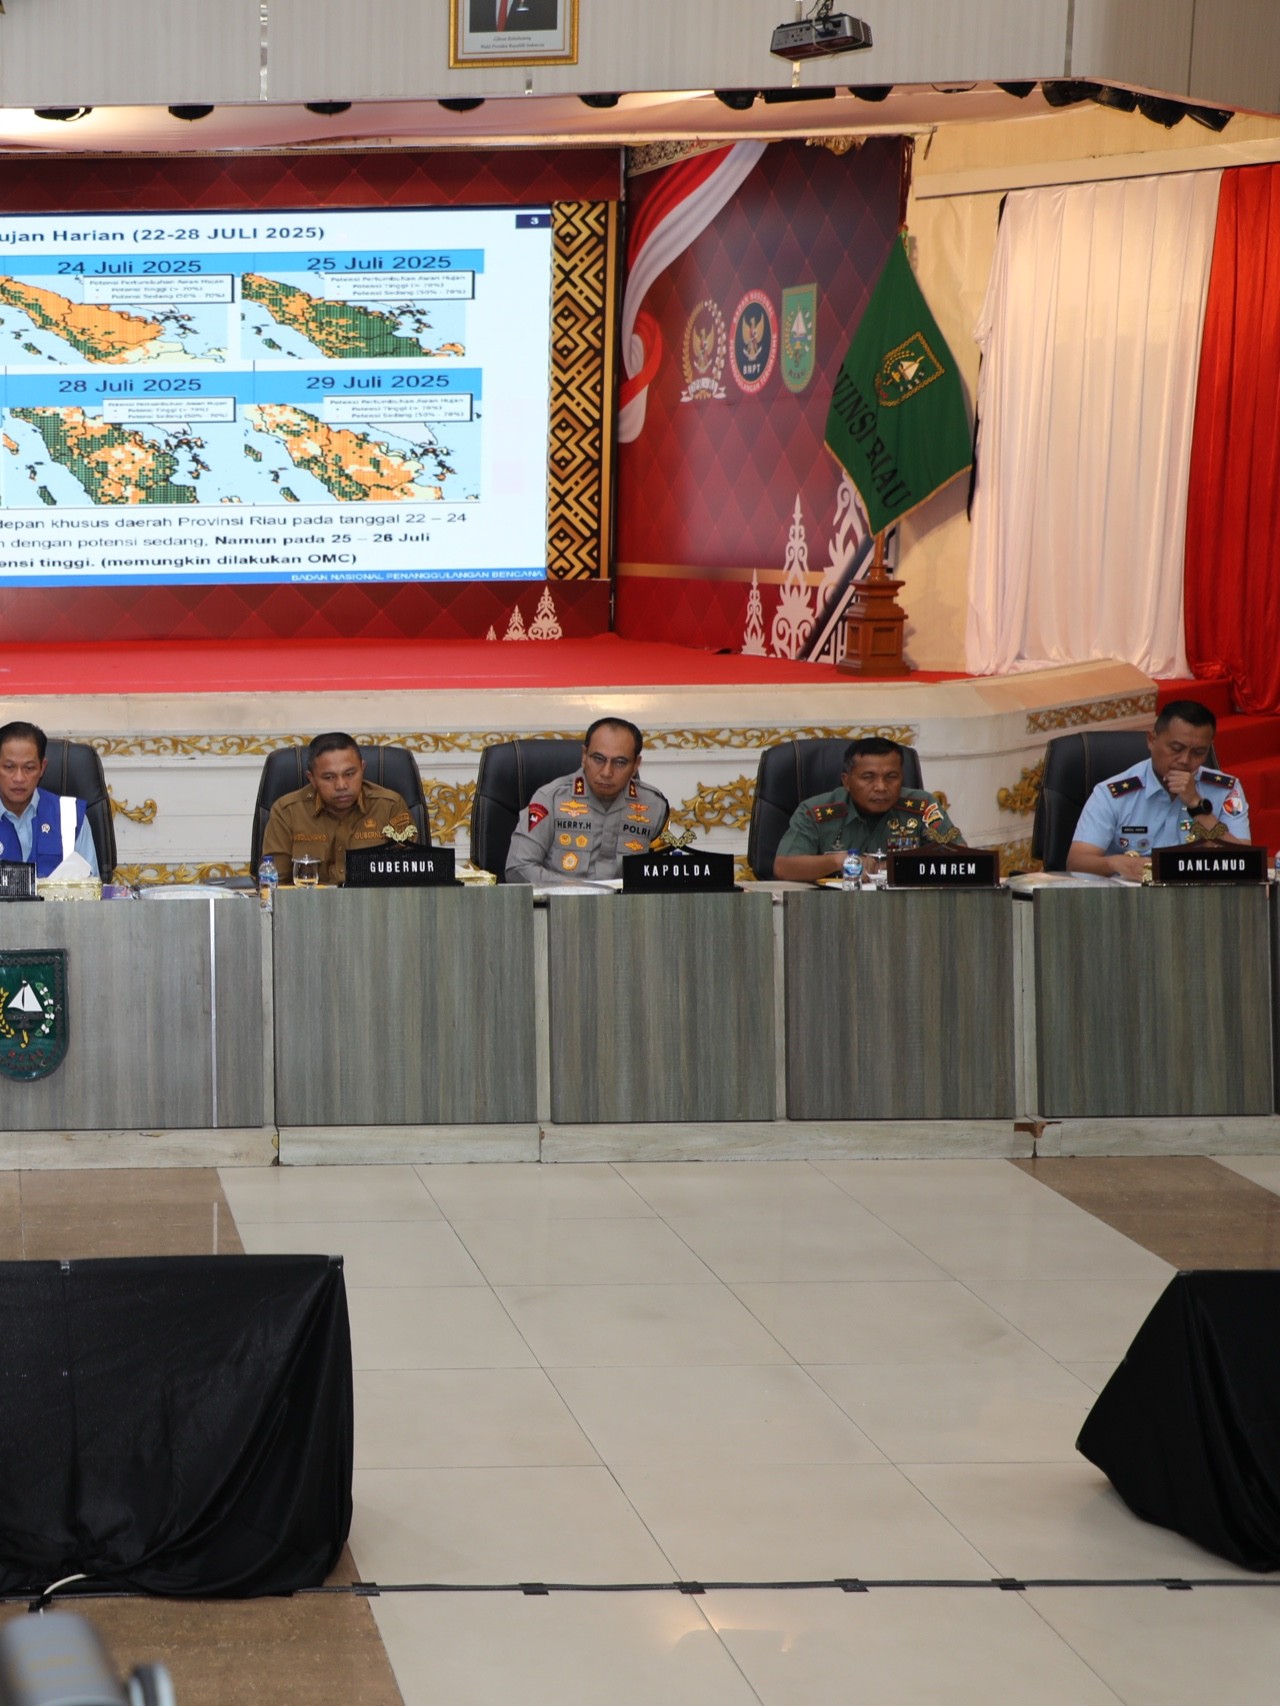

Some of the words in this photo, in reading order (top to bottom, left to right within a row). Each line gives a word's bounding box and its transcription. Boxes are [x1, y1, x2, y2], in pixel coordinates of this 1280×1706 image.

[530, 217, 539, 225] 3
[53, 230, 124, 241] Harian
[133, 229, 200, 243] (22-28
[207, 228, 257, 239] JULI
[266, 227, 324, 240] 2025)
[58, 261, 85, 274] 24
[94, 261, 133, 274] Juli
[143, 260, 201, 273] 2025
[307, 257, 336, 270] 25
[344, 257, 383, 270] Juli
[393, 256, 451, 269] 2025
[743, 364, 761, 375] BNPT
[59, 380, 87, 393] 28
[95, 379, 133, 392] Juli
[143, 378, 201, 392] 2025
[306, 376, 335, 389] 29
[343, 376, 381, 389] Juli
[391, 375, 449, 388] 2025
[832, 363, 878, 443] VINSI
[866, 436, 912, 508] RIAU
[51, 519, 109, 528] khusus
[115, 518, 172, 527] daerah
[178, 517, 243, 526] Provinsi
[250, 516, 287, 525] Riau
[292, 515, 333, 527] pada
[339, 514, 399, 526] tanggal
[406, 514, 425, 523] 22
[447, 513, 466, 522] 24
[10, 538, 72, 550] dengan
[78, 537, 137, 550] potensi
[143, 536, 208, 548] sedang,
[215, 535, 277, 545] Namun
[283, 534, 325, 547] pada
[331, 533, 352, 544] 25
[398, 532, 430, 543] Juli
[40, 559, 94, 569] tinggi.
[101, 556, 210, 568] (memungkin
[217, 555, 301, 565] dilakukan
[308, 554, 357, 564] OMC)
[557, 820, 592, 830] HERRY.H
[623, 824, 651, 837] POLRI
[354, 832, 383, 840] GUBERNU
[370, 860, 434, 873] GUBERNUR
[644, 864, 710, 877] KAPOLDA
[919, 863, 976, 875] DANREM
[1178, 859, 1245, 871] DANLANUD
